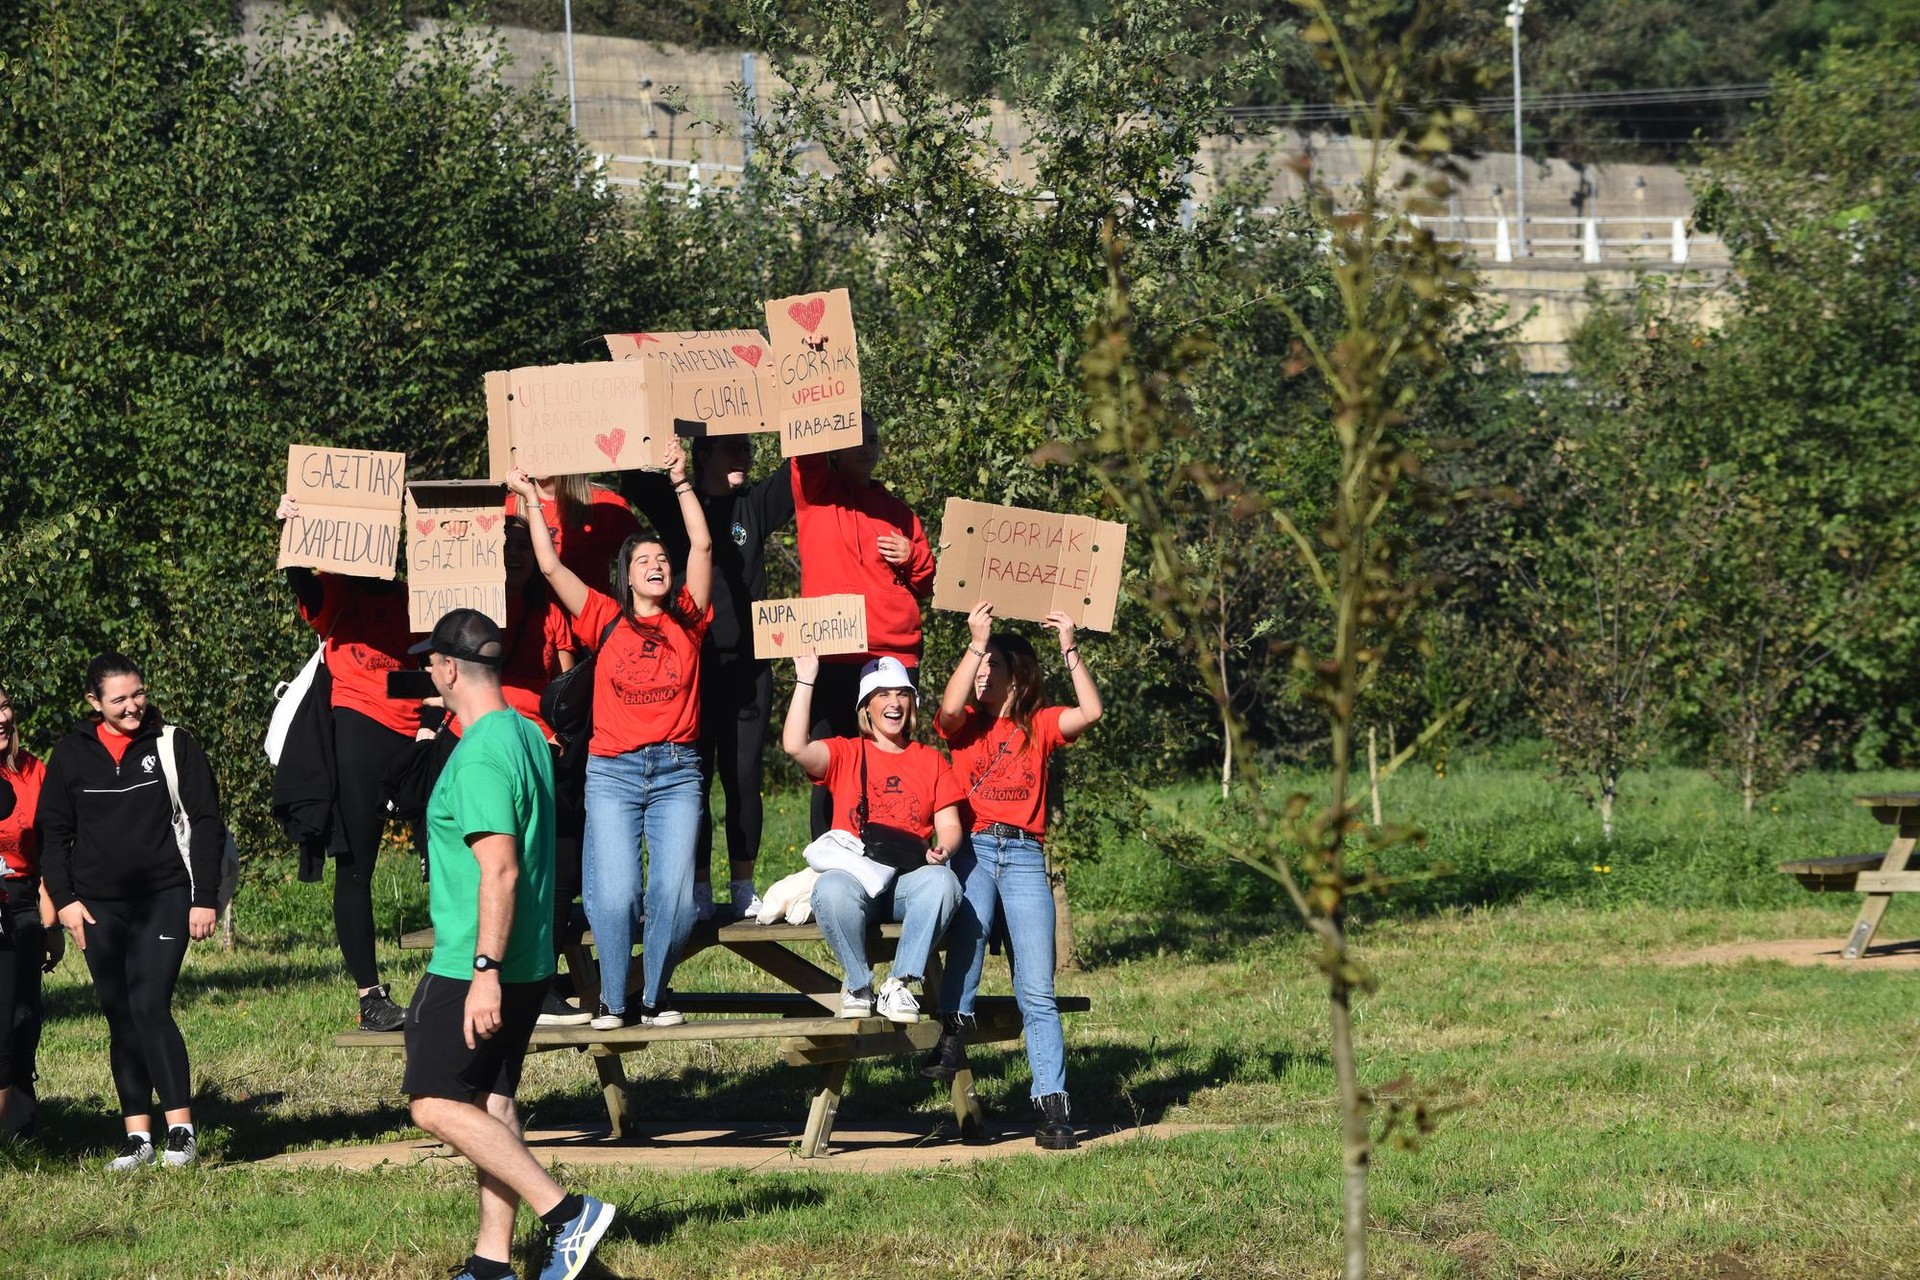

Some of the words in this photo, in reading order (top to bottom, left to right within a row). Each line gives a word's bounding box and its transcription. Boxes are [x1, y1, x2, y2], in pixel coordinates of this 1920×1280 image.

[780, 345, 856, 385] GORRIAK
[792, 377, 845, 405] UPELIO
[788, 412, 857, 440] IRABAZLE
[301, 451, 402, 499] GAZTIAK
[285, 516, 397, 567] TXAPELDUN
[413, 532, 498, 571] GAZTIAK
[981, 518, 1084, 552] GORRIAK
[980, 557, 1098, 596] IRABAZLE!
[758, 604, 796, 625] AUPA
[625, 688, 674, 704] ERRONKA
